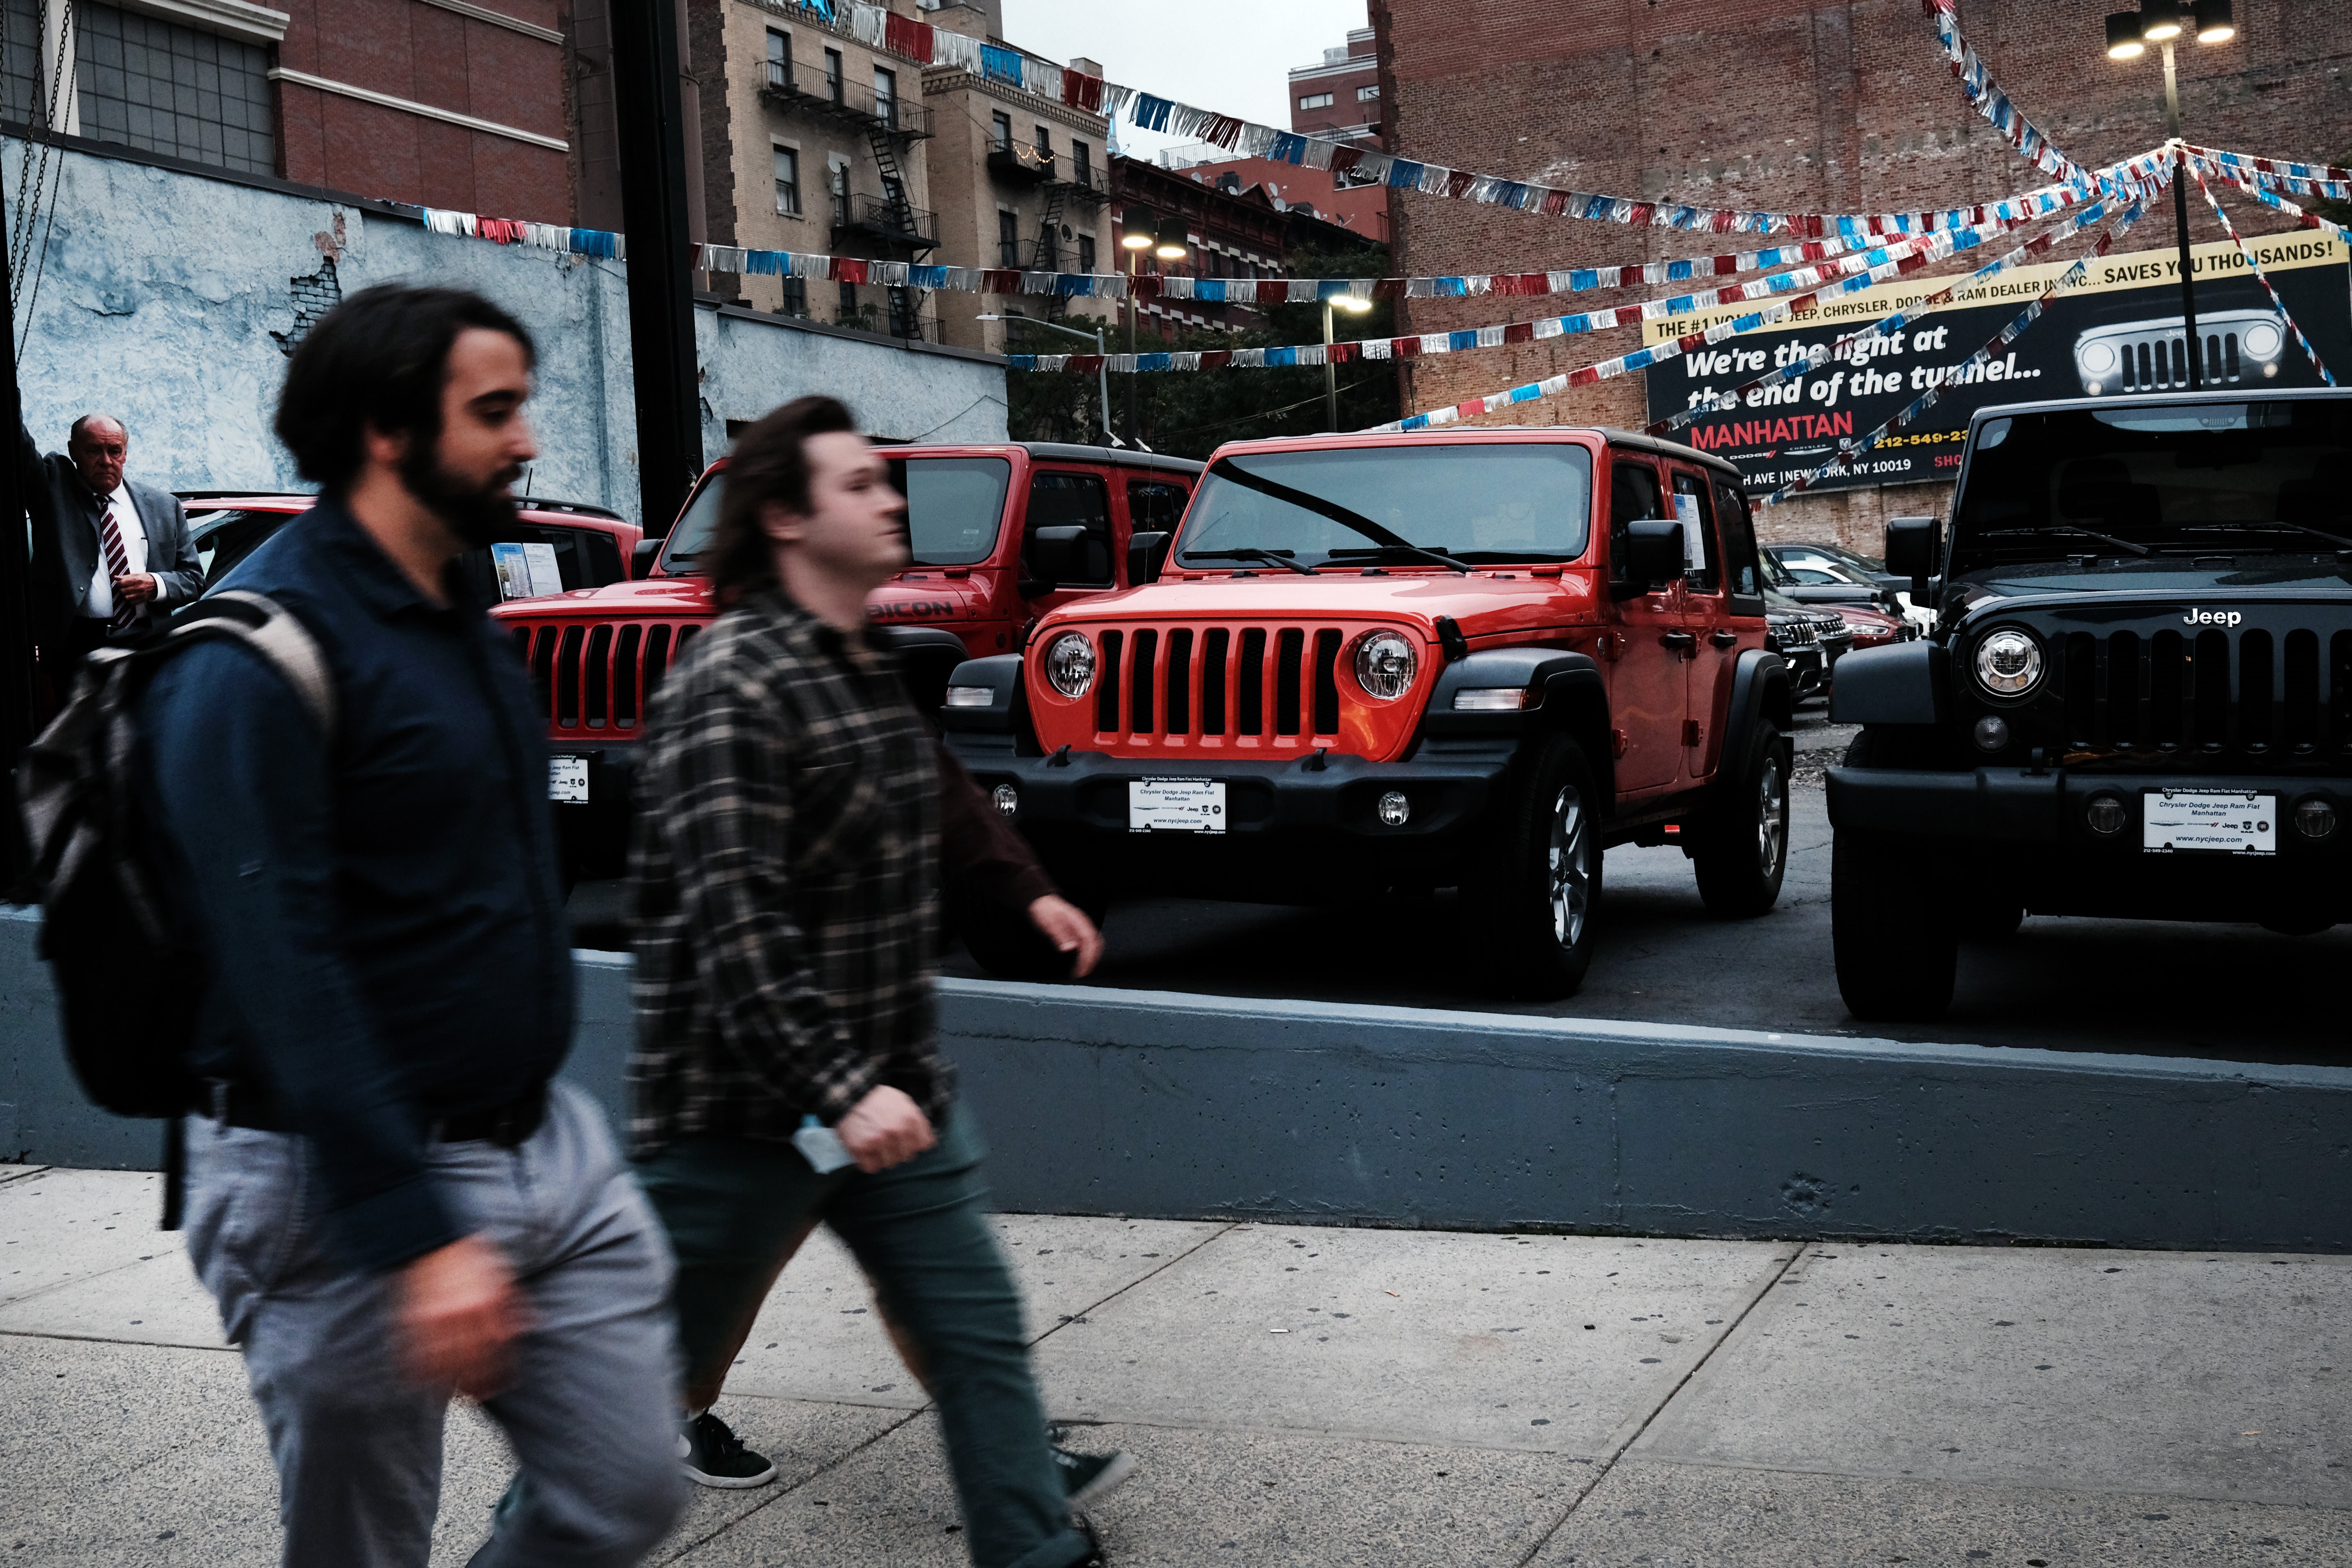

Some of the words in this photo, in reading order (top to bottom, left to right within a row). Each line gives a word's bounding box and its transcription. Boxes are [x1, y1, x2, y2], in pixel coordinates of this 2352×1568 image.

[1656, 321, 1686, 337] THE
[1691, 318, 1708, 333] #1
[1824, 300, 1892, 317] CHRYSLER,
[1958, 288, 1986, 301] RAM
[1991, 282, 2040, 297] DEALER
[2104, 263, 2162, 283] SAVES
[1686, 348, 1766, 378] We're
[1774, 340, 1826, 368] the
[1834, 331, 1905, 366] light
[1913, 326, 1948, 352] at
[1688, 386, 1736, 412] the
[1746, 376, 1803, 407] end
[1810, 372, 1845, 407] of
[1849, 368, 1902, 396] the
[1691, 412, 1853, 450] MANHATTAN
[1754, 472, 1775, 485] AVE
[1853, 462, 1869, 475] NY
[1872, 459, 1911, 473] 10019
[2183, 608, 2242, 627] Jeep
